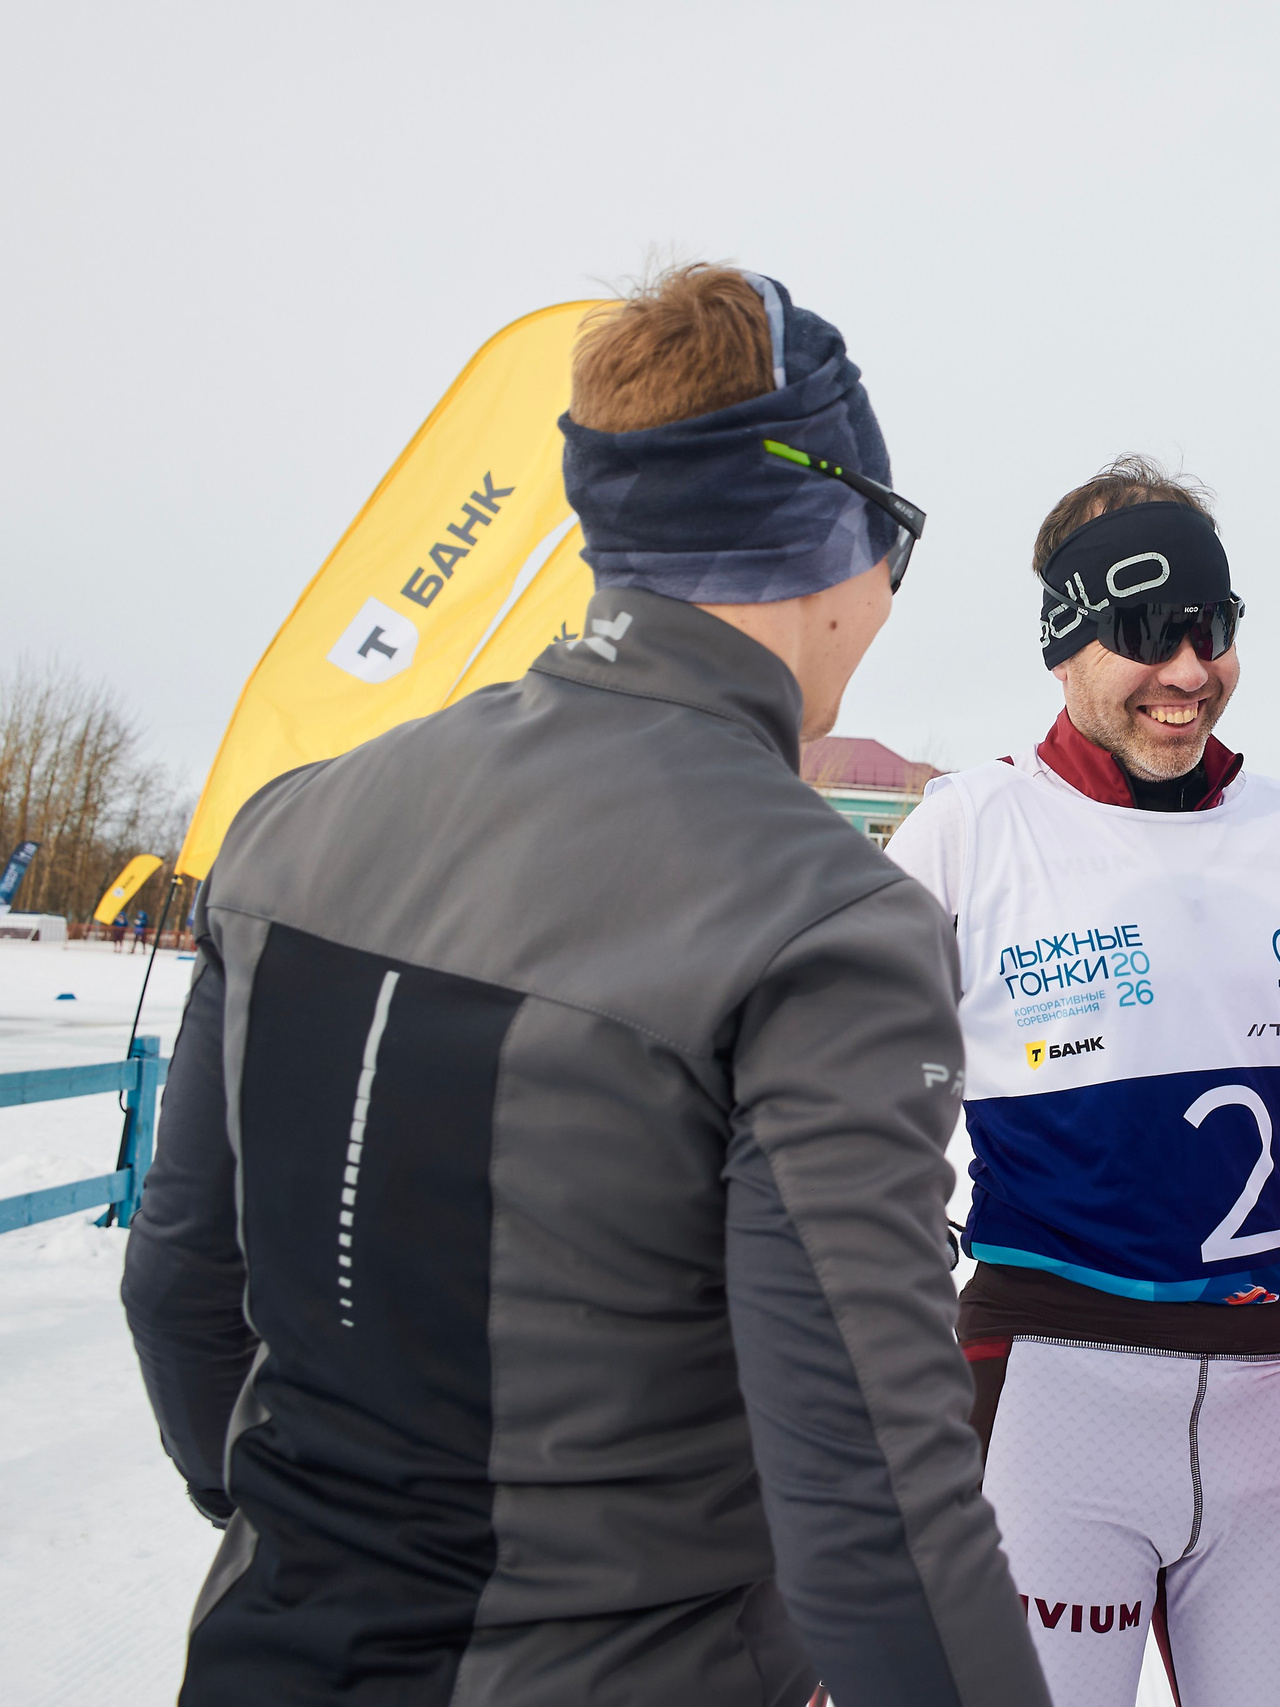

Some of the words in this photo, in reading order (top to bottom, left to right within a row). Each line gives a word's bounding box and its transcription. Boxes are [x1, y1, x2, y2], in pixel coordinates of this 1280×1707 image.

[400, 470, 516, 609] БАНК
[999, 924, 1143, 975] ЛЫЖНЫЕ
[1110, 950, 1151, 977] 20
[1004, 955, 1110, 999] ГОНКИ
[1013, 989, 1106, 1017] КОРПОРАТИВНЫЕ
[1116, 979, 1155, 1007] 26
[1016, 1002, 1100, 1028] СОРЕВНОВАНИЯ
[1049, 1035, 1106, 1059] БАНК
